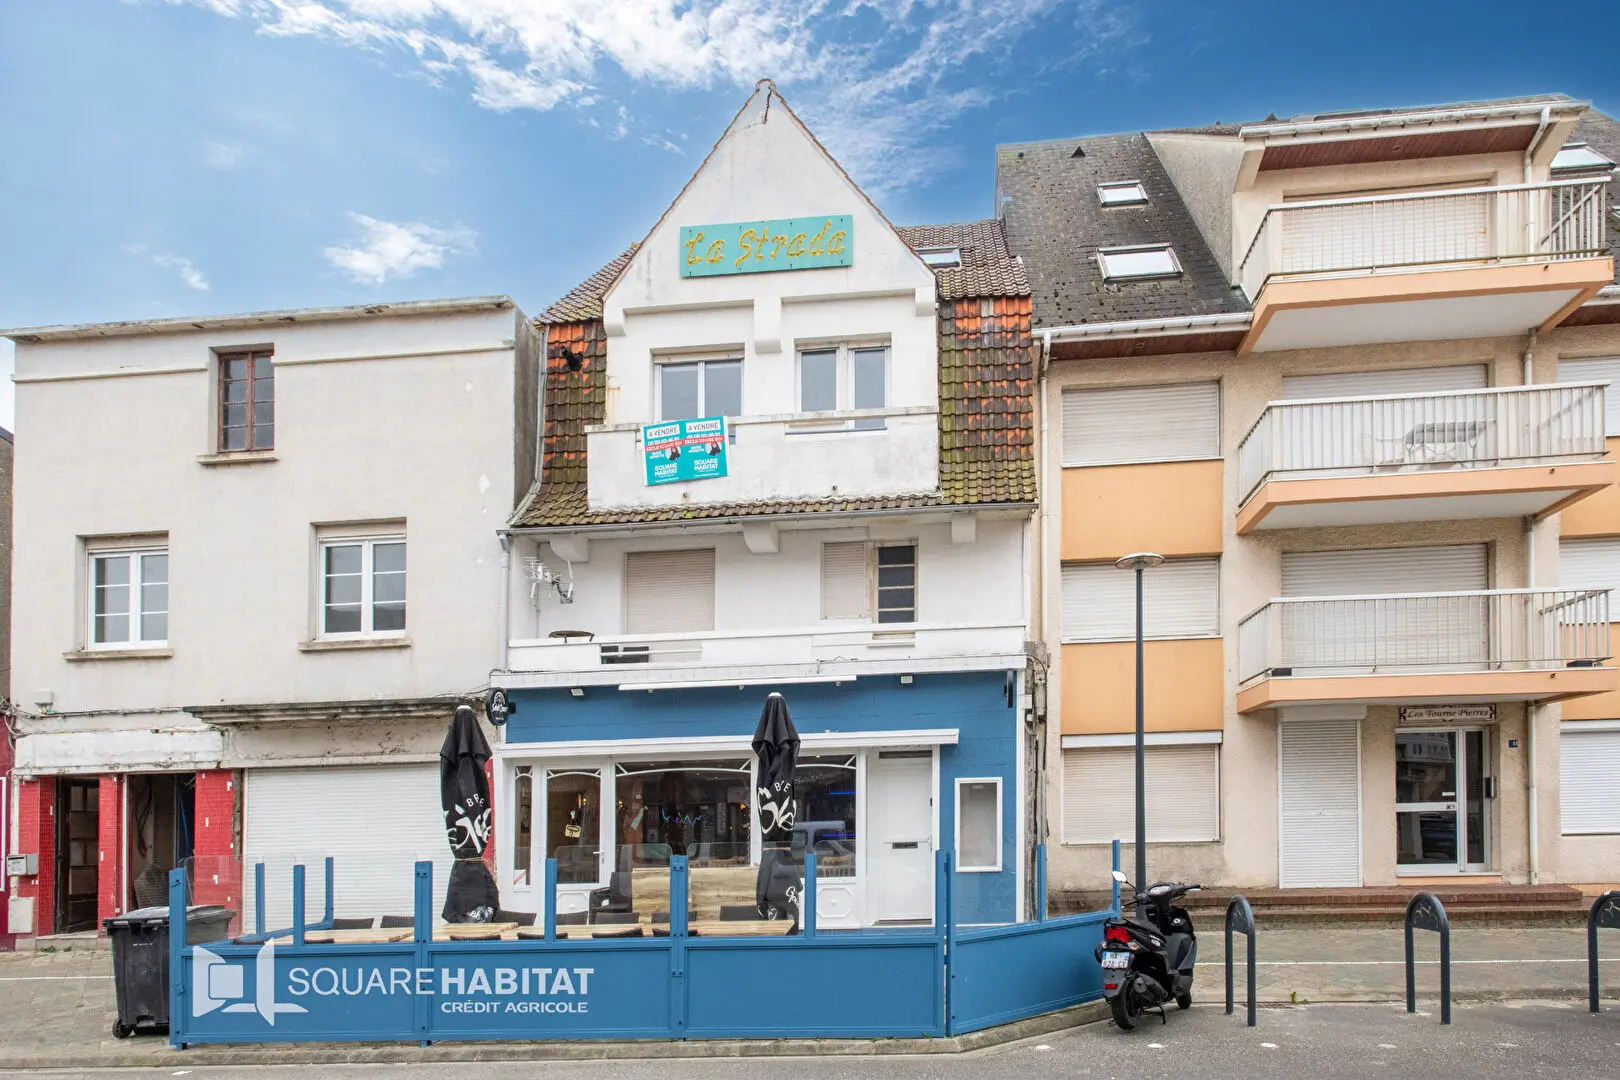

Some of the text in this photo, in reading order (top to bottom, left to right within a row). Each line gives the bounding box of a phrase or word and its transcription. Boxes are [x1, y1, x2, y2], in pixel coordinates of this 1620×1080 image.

[685, 220, 847, 268] La Strada
[654, 427, 678, 437] VENDRE
[1407, 709, 1489, 718] Les Tourne Pierres
